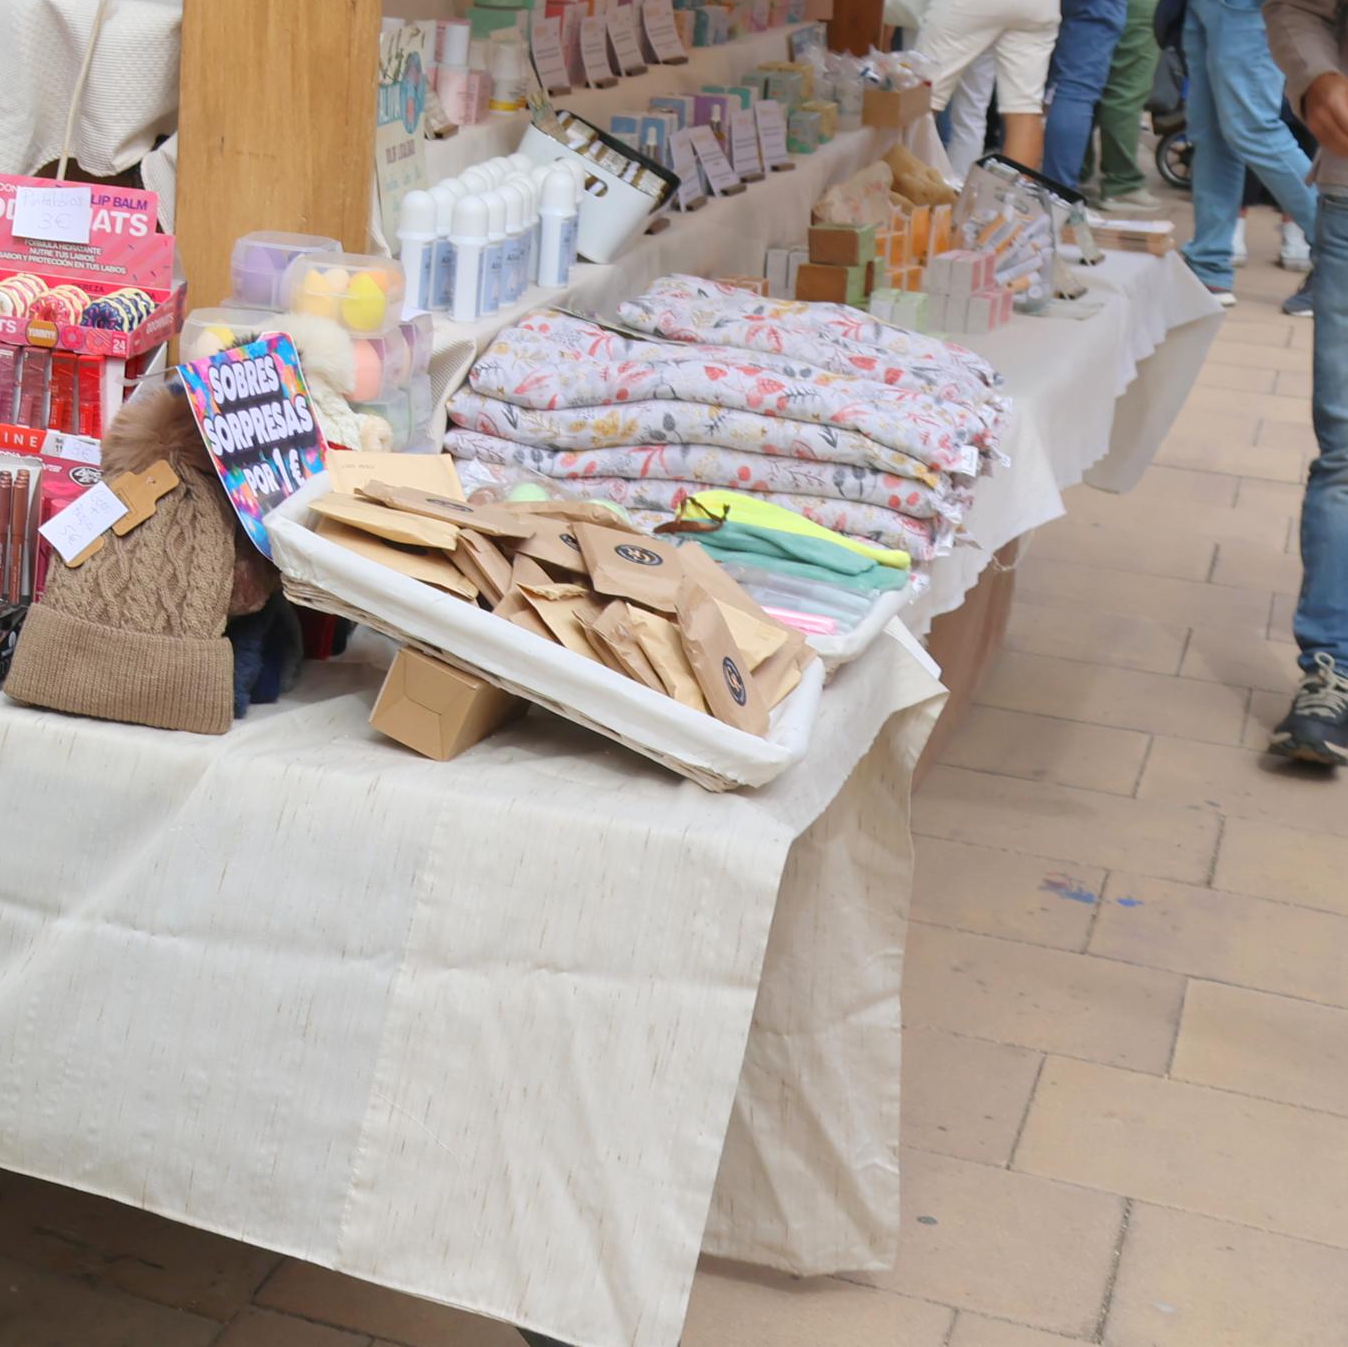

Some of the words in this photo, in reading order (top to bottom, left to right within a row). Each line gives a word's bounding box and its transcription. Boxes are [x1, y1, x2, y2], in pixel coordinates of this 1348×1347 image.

[90, 194, 111, 206] LIP
[113, 197, 148, 211] BALM
[29, 247, 53, 257] NUTRE
[54, 250, 71, 259] TUS
[72, 252, 96, 262] LABIOS
[58, 242, 102, 255] HIDRATANTE
[75, 260, 84, 269] EN
[85, 262, 99, 271] TUS
[100, 264, 127, 274] LABIOS
[112, 338, 126, 351] 24
[208, 355, 280, 405] SOBRES
[203, 395, 314, 456] SORPRESAS
[242, 462, 281, 498] POR
[272, 448, 293, 493] 1
